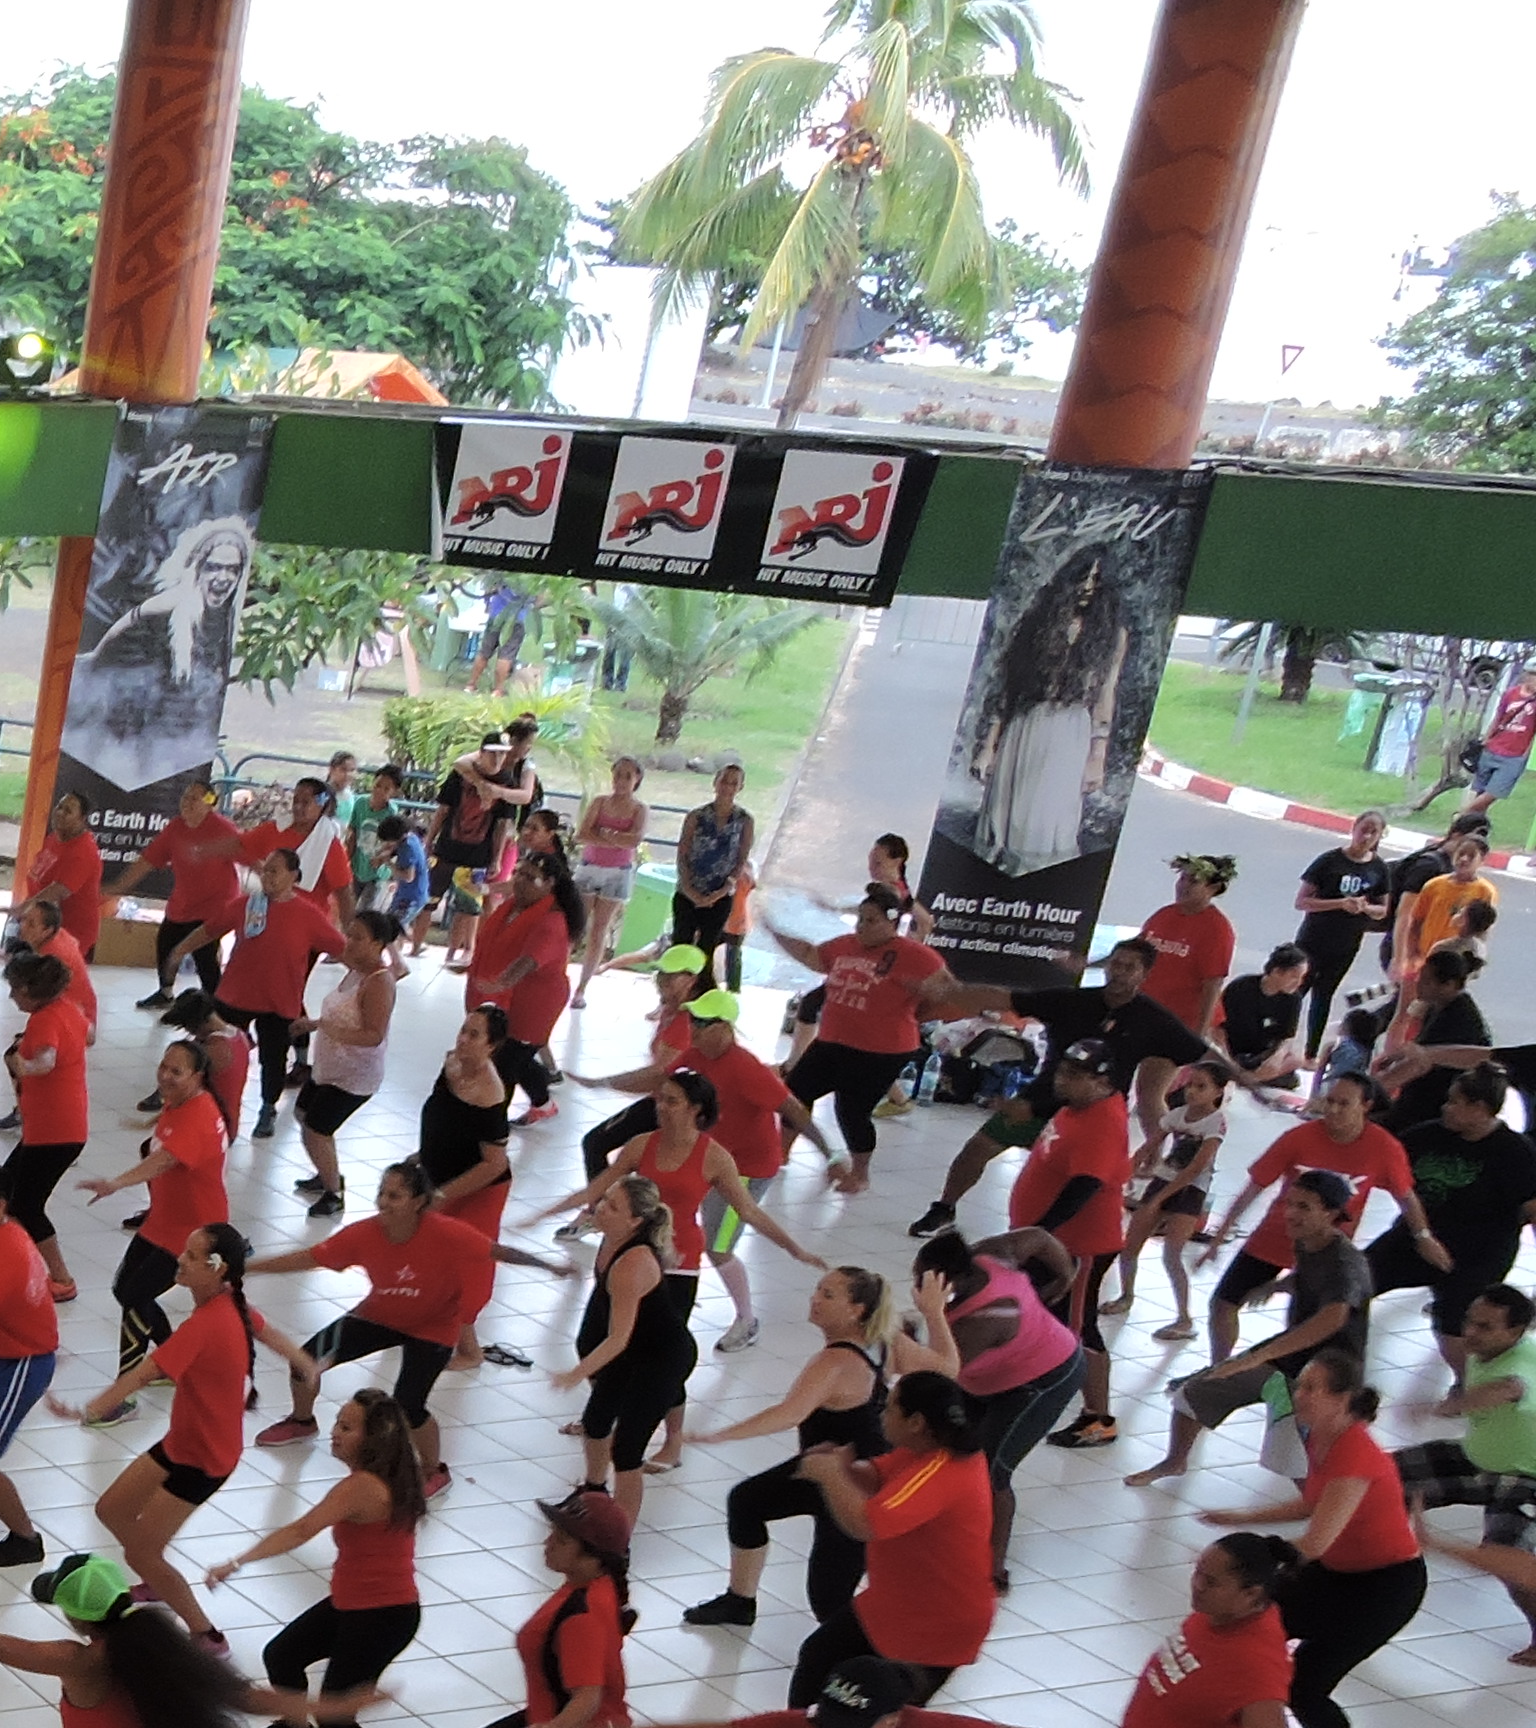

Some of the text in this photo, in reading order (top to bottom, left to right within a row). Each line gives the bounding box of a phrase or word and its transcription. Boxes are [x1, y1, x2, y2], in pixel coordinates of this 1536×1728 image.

[462, 540, 504, 555] MUSIC
[506, 543, 537, 559] ONLY
[594, 552, 617, 566] HIT
[619, 555, 663, 571] MUSIC
[665, 559, 700, 575] ONLY
[756, 567, 781, 582] HIT
[781, 571, 827, 588] MUSIC
[829, 575, 865, 590] ONLY
[103, 809, 146, 829] Earth
[930, 892, 1082, 924] Avec Earth Hour
[994, 922, 1015, 936] en
[959, 938, 1000, 952] action
